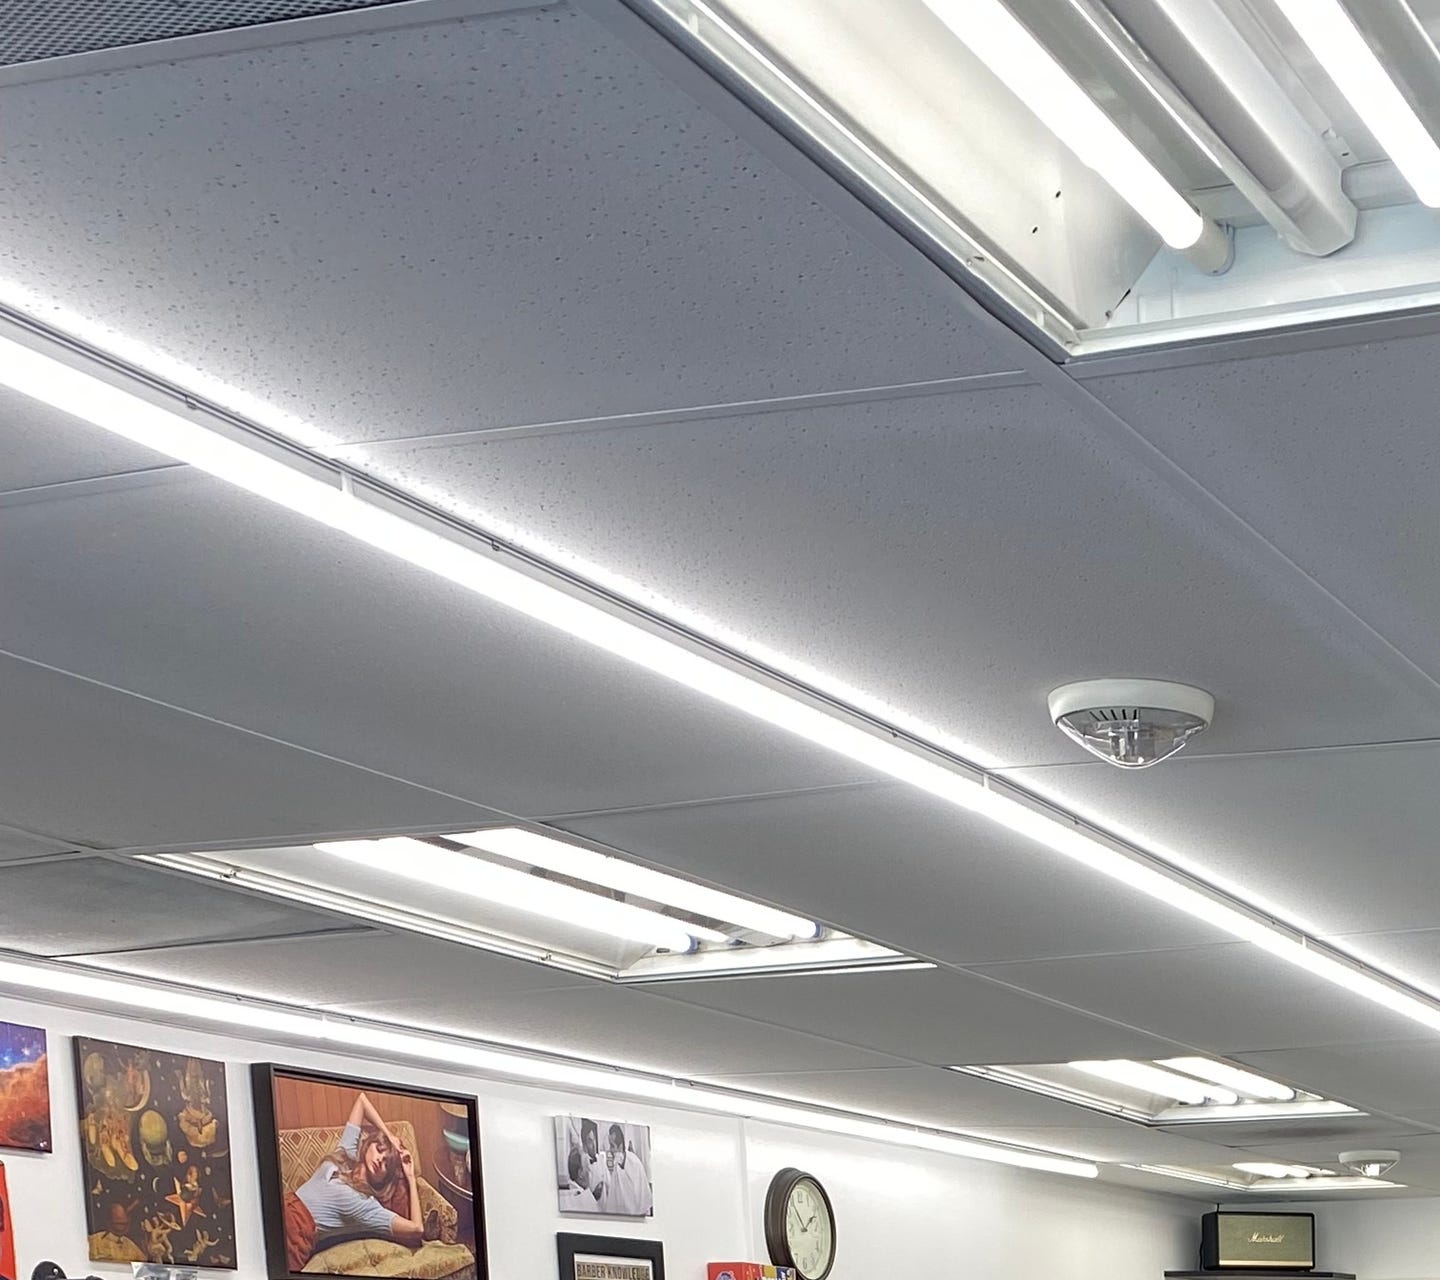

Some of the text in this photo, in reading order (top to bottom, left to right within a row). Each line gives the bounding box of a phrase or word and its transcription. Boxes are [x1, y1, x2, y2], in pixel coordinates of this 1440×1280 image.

[1247, 1231, 1286, 1244] Marshall
[577, 1263, 650, 1280] BARBER KNOWLEDGE
